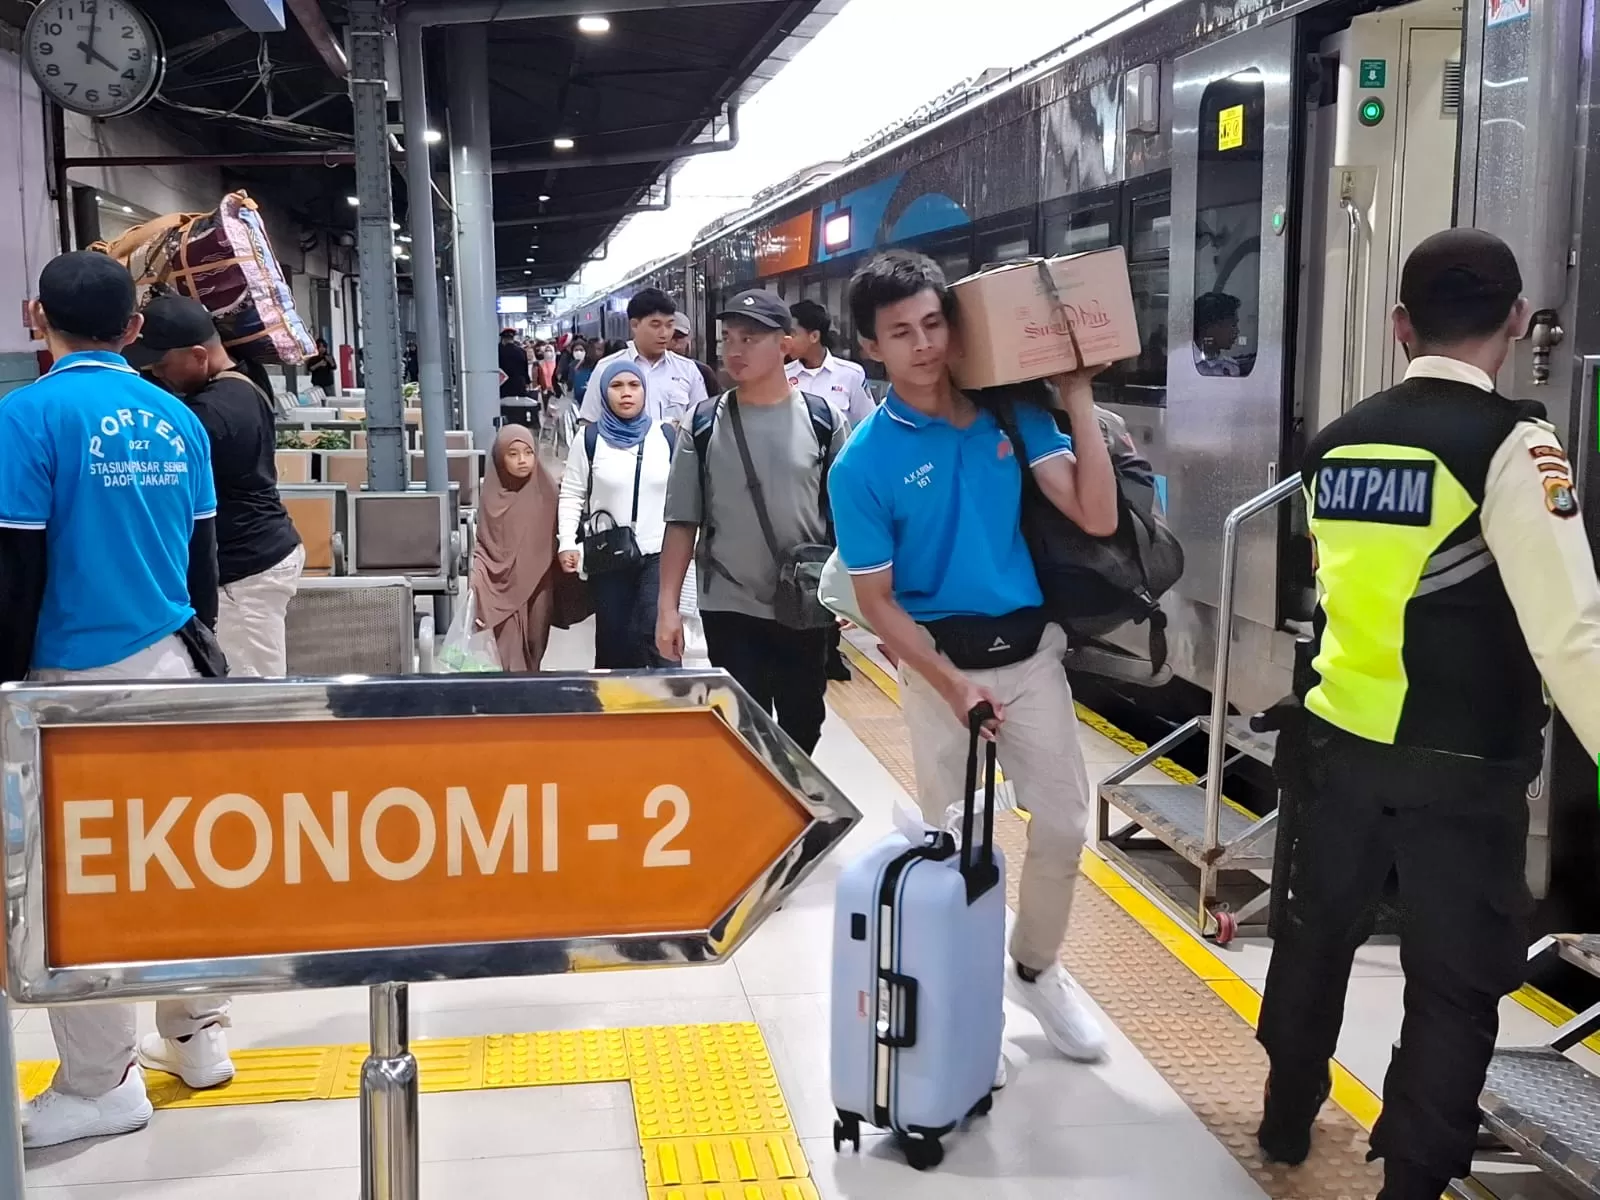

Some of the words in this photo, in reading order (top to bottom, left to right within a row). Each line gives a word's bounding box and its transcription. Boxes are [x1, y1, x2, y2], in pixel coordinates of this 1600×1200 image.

[80, 0, 97, 13] 12
[58, 7, 73, 20] 11
[109, 8, 114, 20] 1
[44, 23, 62, 36] 10
[121, 26, 134, 39] 2
[39, 42, 53, 55] 9
[128, 48, 141, 61] 3
[46, 64, 60, 76] 8
[121, 68, 136, 81] 4
[64, 82, 78, 95] 7
[108, 84, 122, 97] 5
[85, 89, 99, 102] 6
[89, 408, 186, 458] PORTER
[128, 440, 151, 450] 027
[140, 474, 180, 486] JAKARTA
[916, 475, 932, 489] 151
[1318, 466, 1427, 513] SATPAM
[63, 783, 558, 894] EKONOMI
[643, 784, 691, 867] 2
